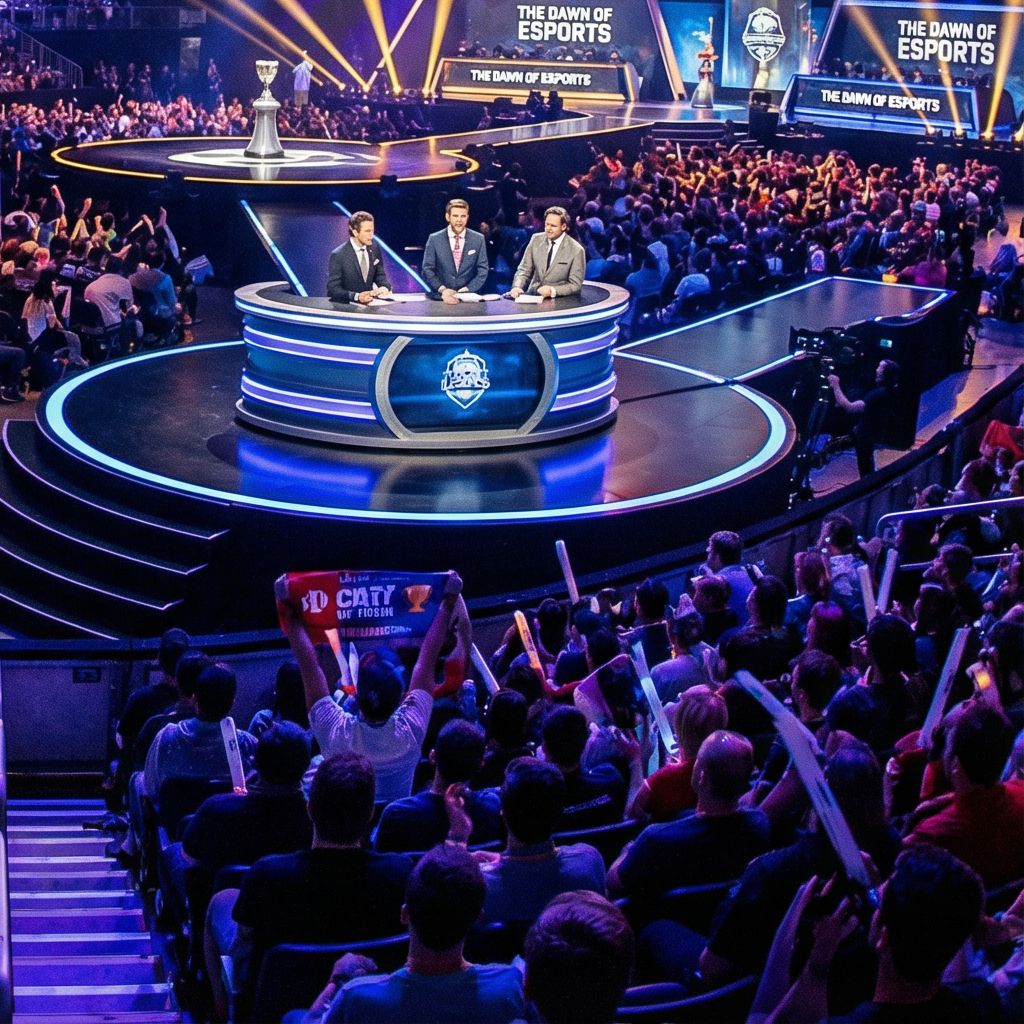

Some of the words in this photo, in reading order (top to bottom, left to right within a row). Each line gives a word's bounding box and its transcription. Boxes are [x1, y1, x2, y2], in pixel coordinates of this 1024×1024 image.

[517, 5, 545, 20] THE
[548, 6, 591, 21] DAWN
[593, 7, 613, 22] OF
[518, 20, 612, 43] ESPORTS
[898, 20, 927, 36] THE
[929, 21, 973, 39] DAWN
[976, 23, 997, 40] OF
[898, 37, 995, 65] ESPORTS
[470, 69, 491, 82] THE
[525, 72, 539, 84] OF
[821, 89, 840, 103] THE
[872, 94, 886, 107] OF
[888, 96, 940, 112] ESPORTS
